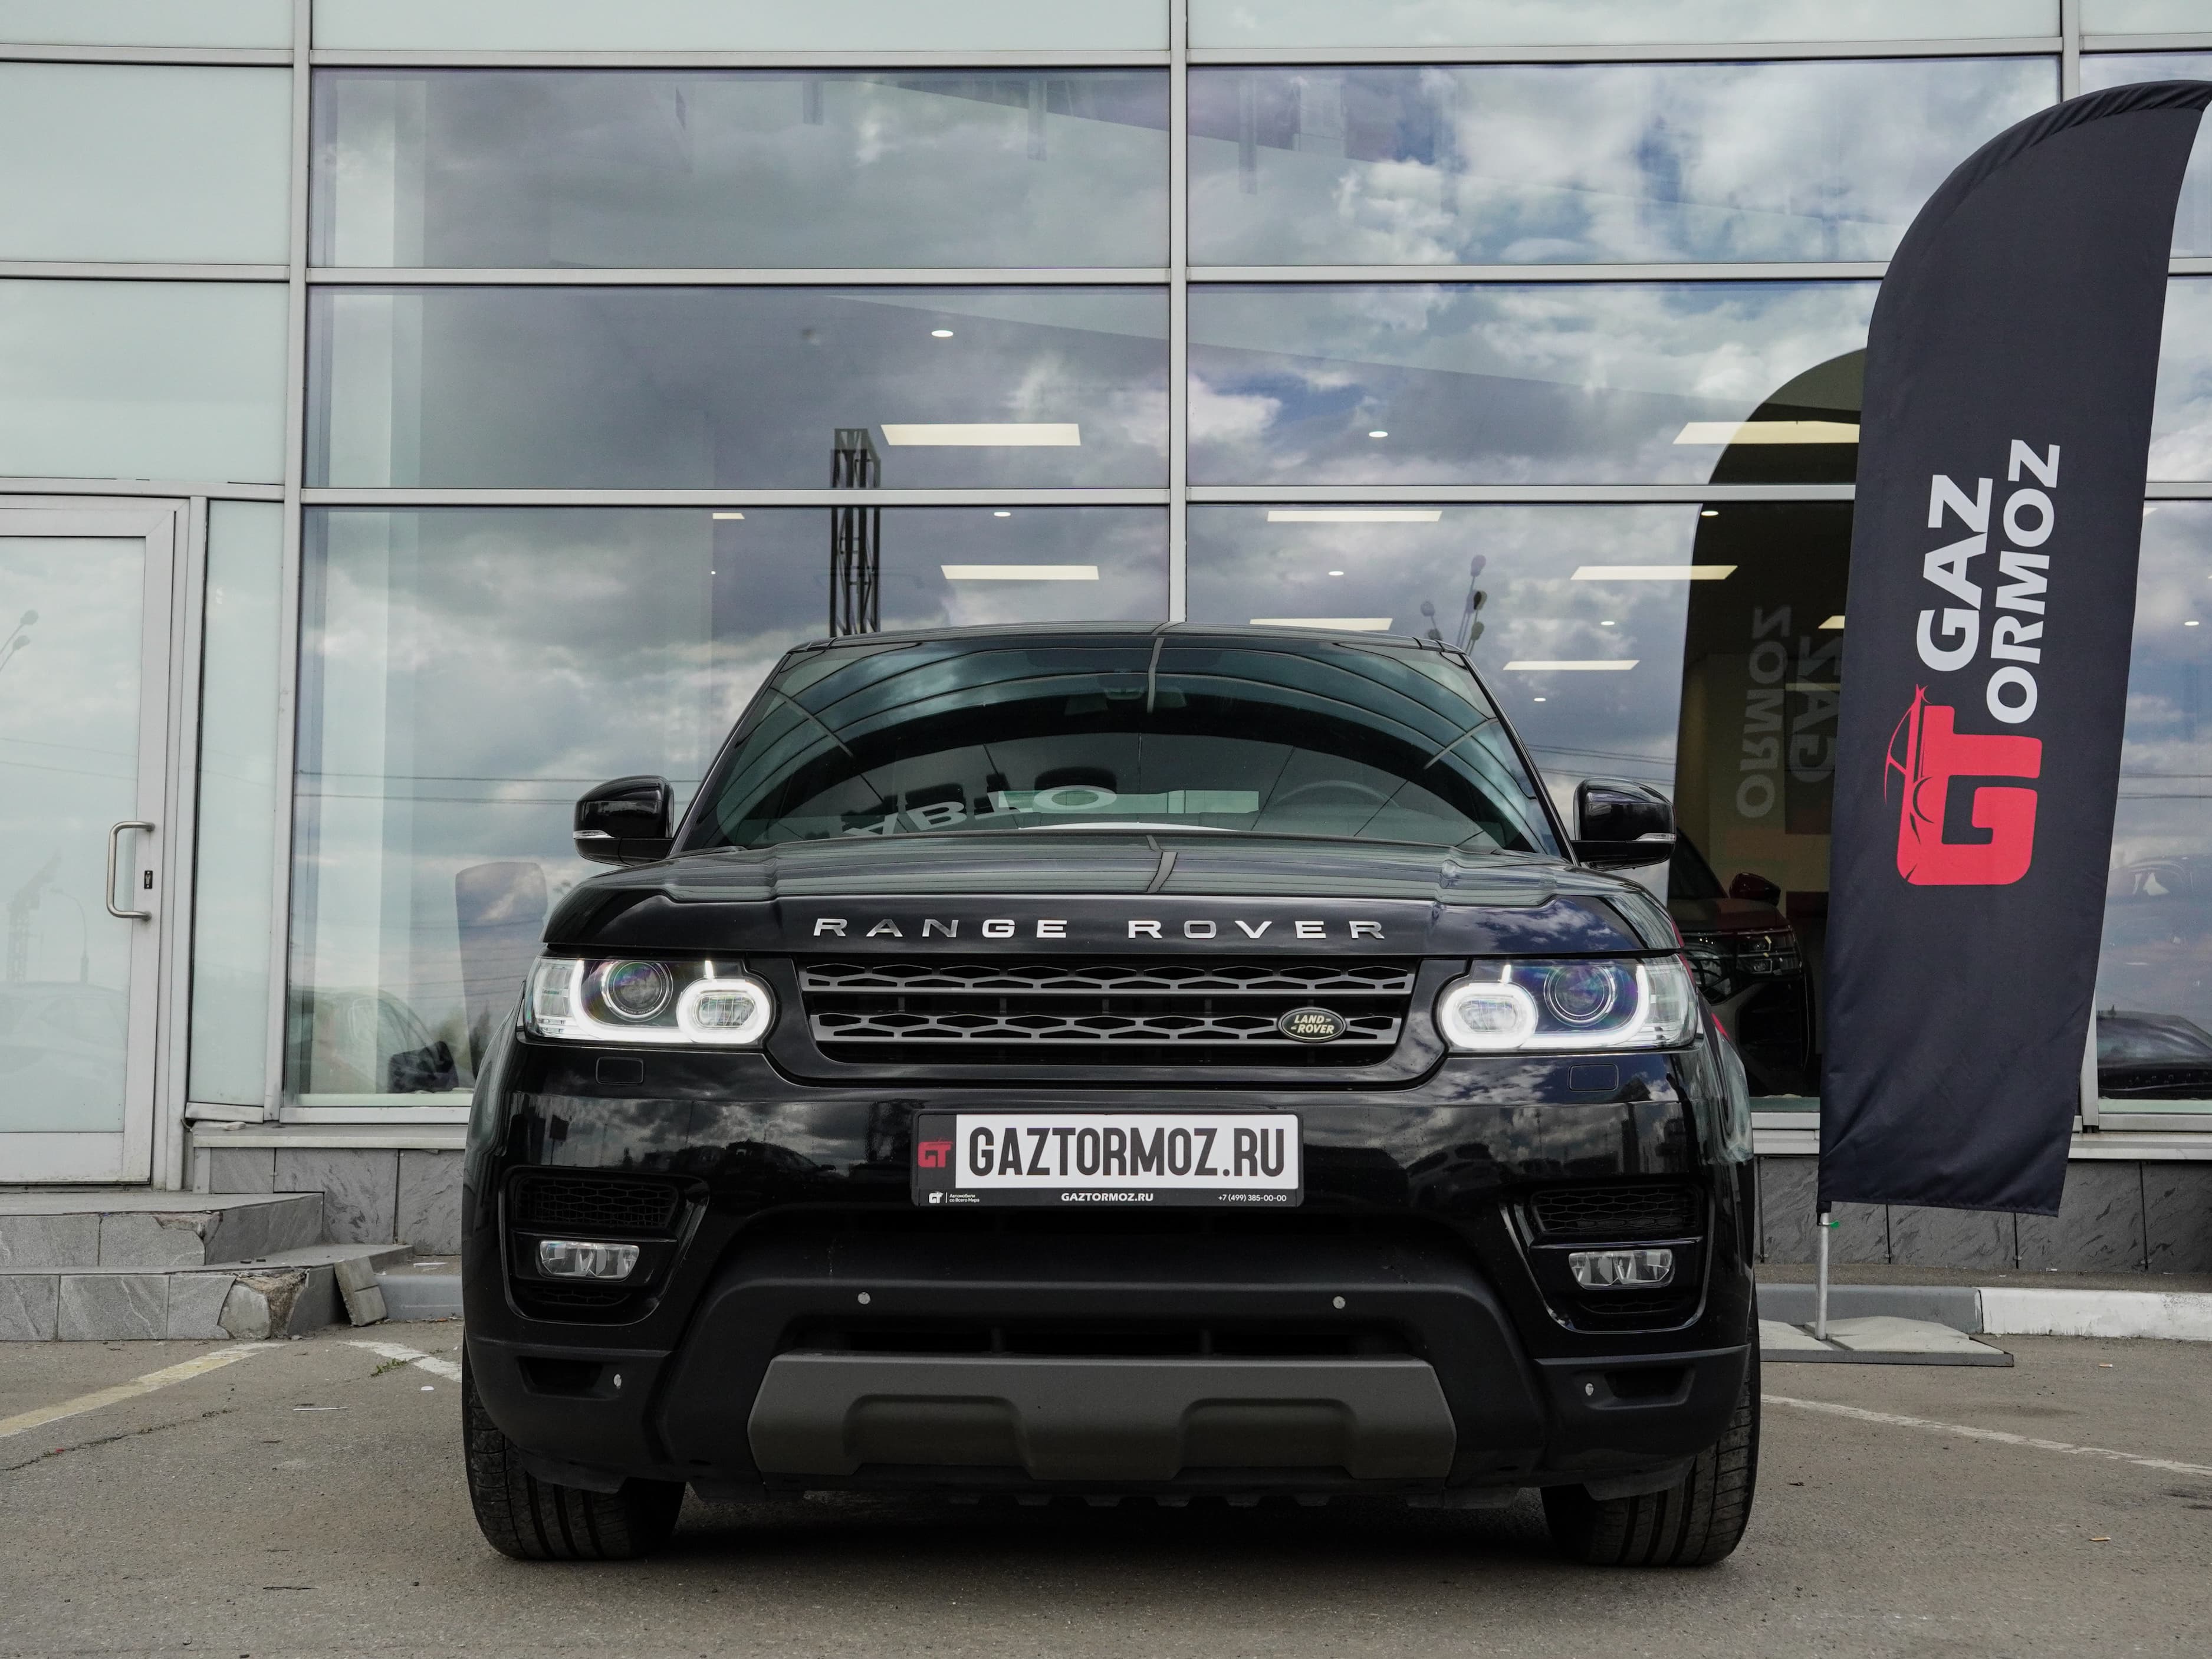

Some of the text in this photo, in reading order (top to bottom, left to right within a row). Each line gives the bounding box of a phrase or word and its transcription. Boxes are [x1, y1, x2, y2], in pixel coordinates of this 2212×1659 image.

[1916, 474, 1993, 672] GAZ
[1986, 438, 2060, 724] ORMOZ
[813, 918, 1385, 939] RANGE ROVER
[969, 1126, 1284, 1177] GAZTORMOZ.RU
[1061, 1192, 1153, 1202] GAZTORMOZ.RU
